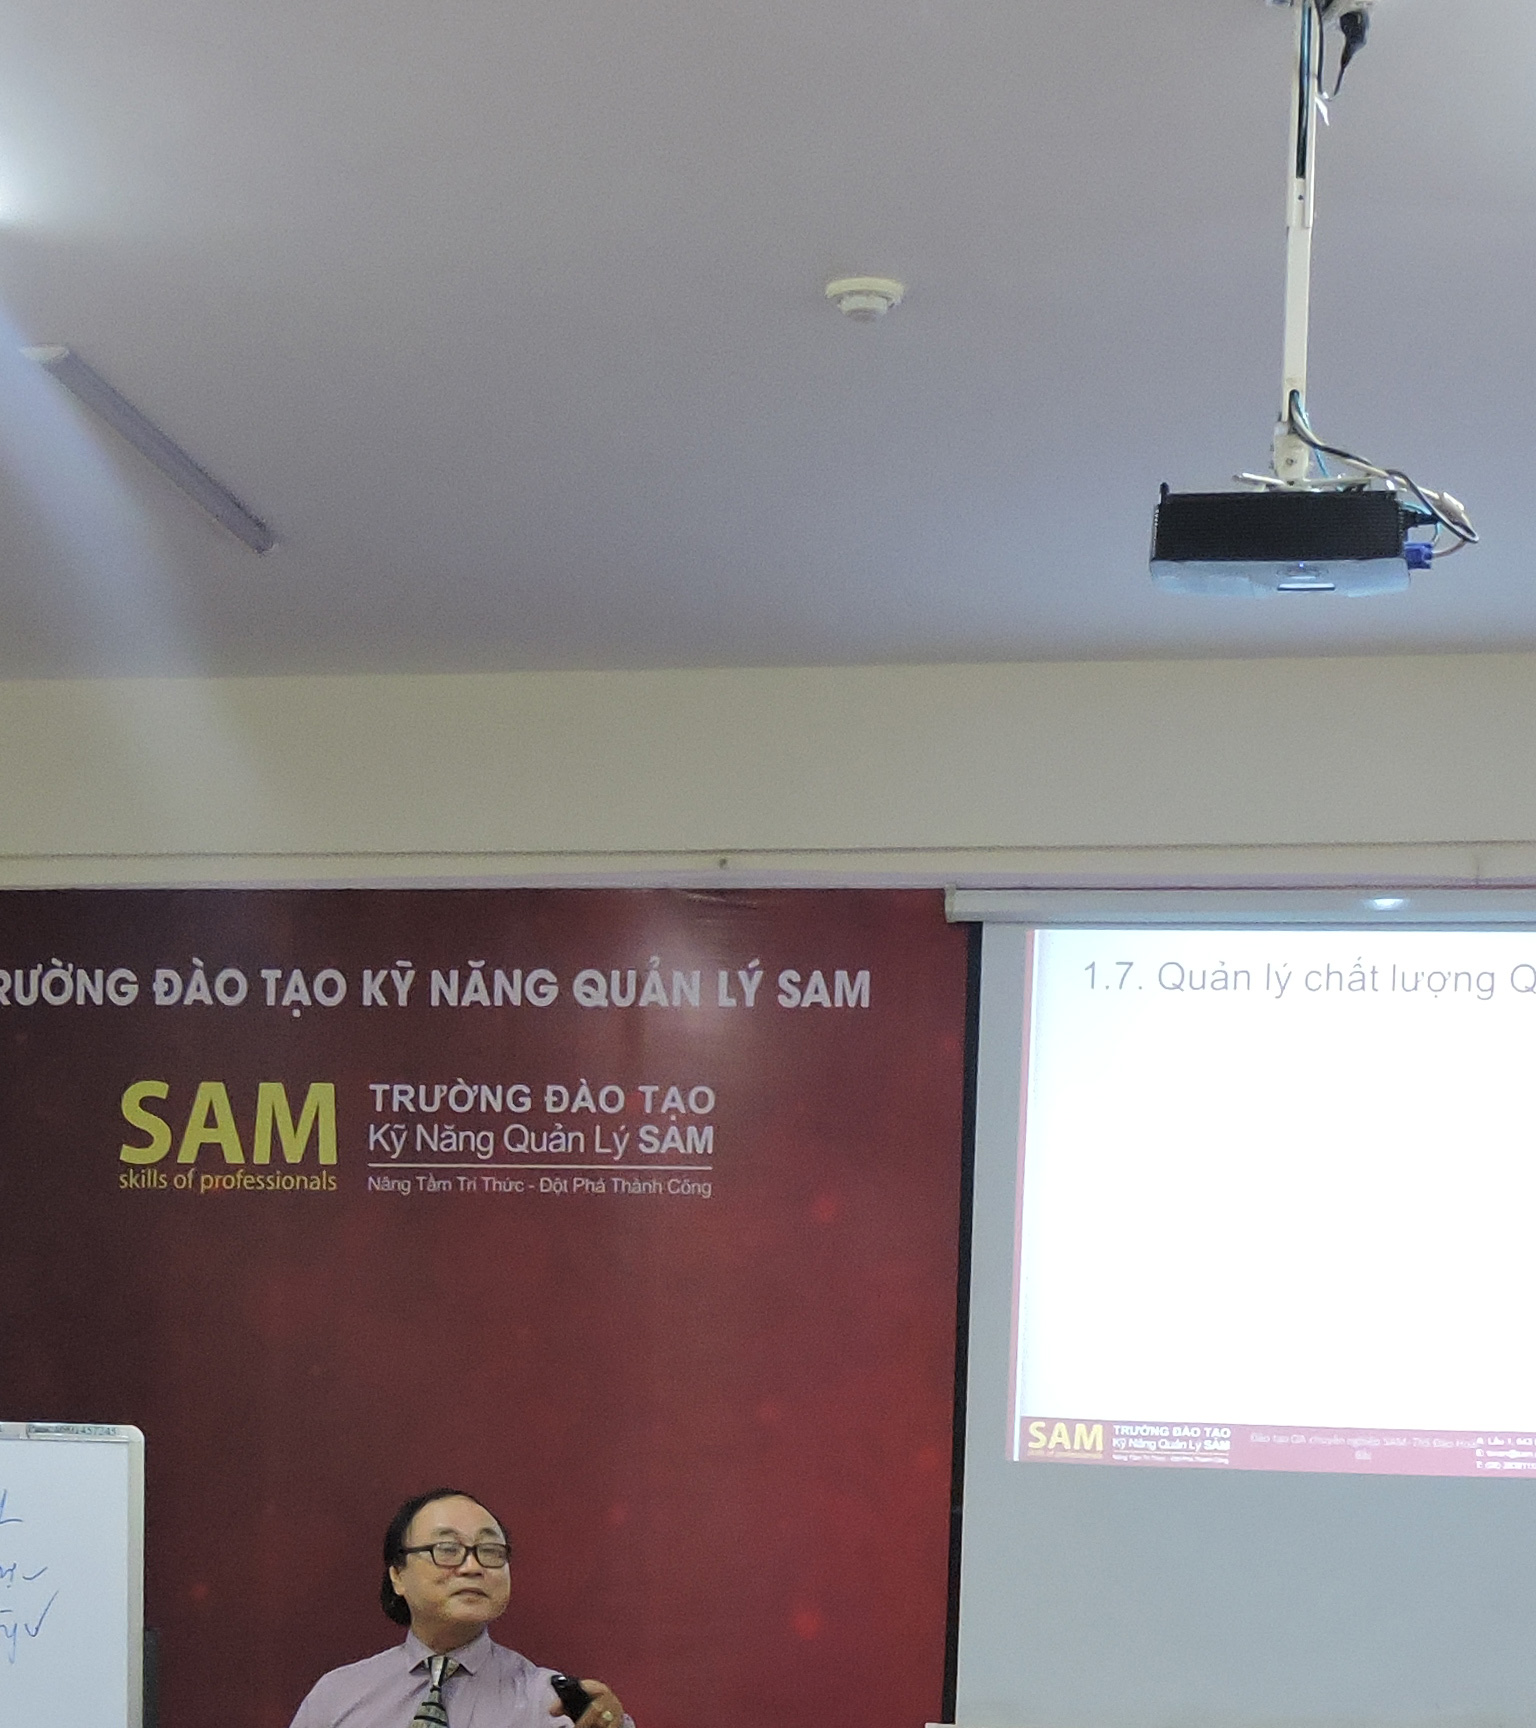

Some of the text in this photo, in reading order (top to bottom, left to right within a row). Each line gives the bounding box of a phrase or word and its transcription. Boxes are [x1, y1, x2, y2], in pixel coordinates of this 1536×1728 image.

[153, 957, 248, 1006] ĐÀO
[261, 968, 347, 1018] TẠO
[363, 960, 416, 1006] KỸ
[431, 959, 559, 1007] NĂNG
[573, 955, 700, 1008] QUẢN
[718, 958, 762, 1007] LÝ
[778, 969, 871, 1008] SAM
[1084, 961, 1143, 990] 1.7.
[1158, 960, 1251, 992] Quản
[1266, 962, 1292, 999] lý
[1305, 956, 1378, 992] chất
[1392, 964, 1495, 1000] lượng
[369, 1078, 715, 1121] TRƯỜNG ĐÀO TẠO
[119, 1080, 337, 1165] SAM
[369, 1123, 713, 1160] Kỹ Năng Quản Lý SAM
[119, 1168, 337, 1194] skills of professionals
[368, 1176, 411, 1195] Nâng
[612, 1177, 662, 1193] Thành
[667, 1177, 712, 1198] Công
[1028, 1421, 1104, 1451] SAM
